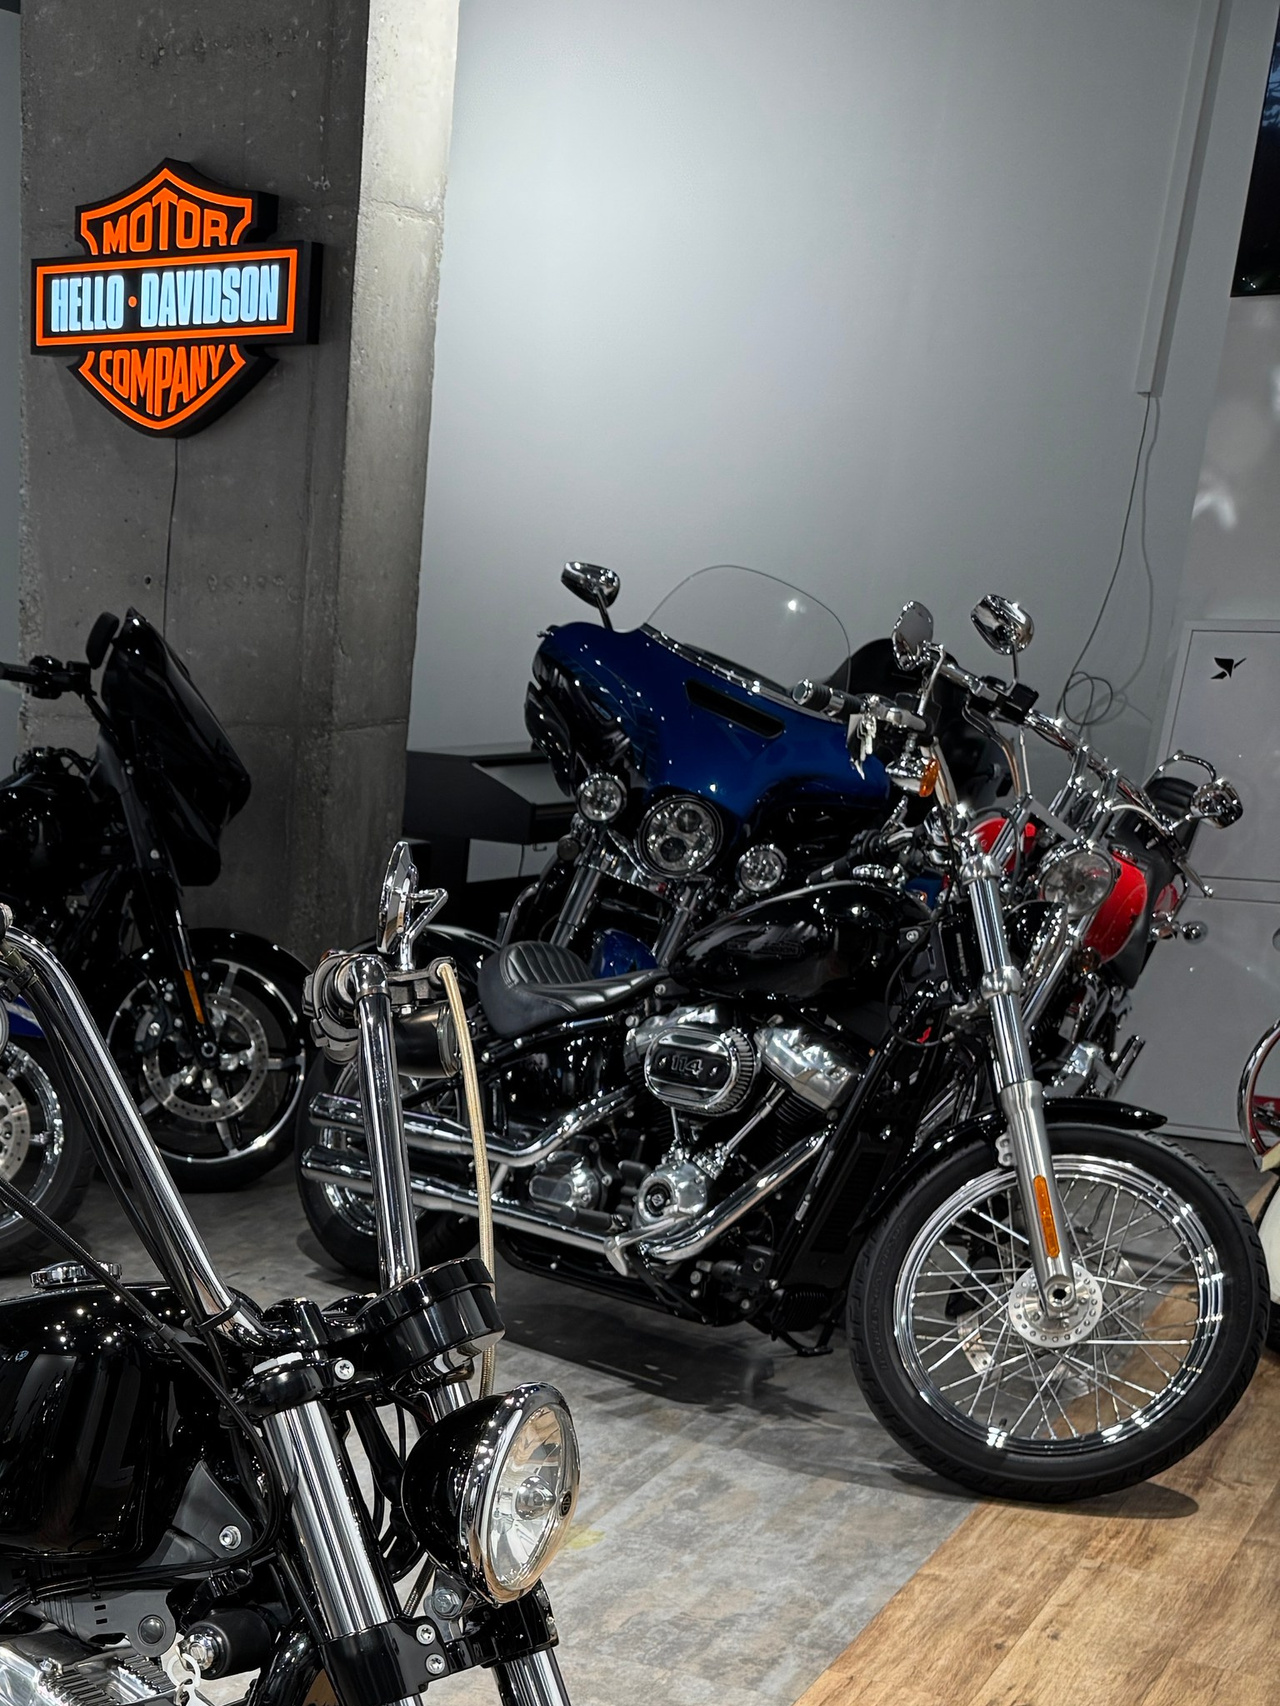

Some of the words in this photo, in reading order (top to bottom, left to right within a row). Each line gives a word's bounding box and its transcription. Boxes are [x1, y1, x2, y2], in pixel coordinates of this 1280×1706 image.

[103, 187, 228, 255] MOTOR
[51, 275, 125, 332] HELLO
[140, 264, 280, 328] DAVIDSON
[99, 344, 226, 417] COMPANY
[671, 1054, 704, 1076] 114
